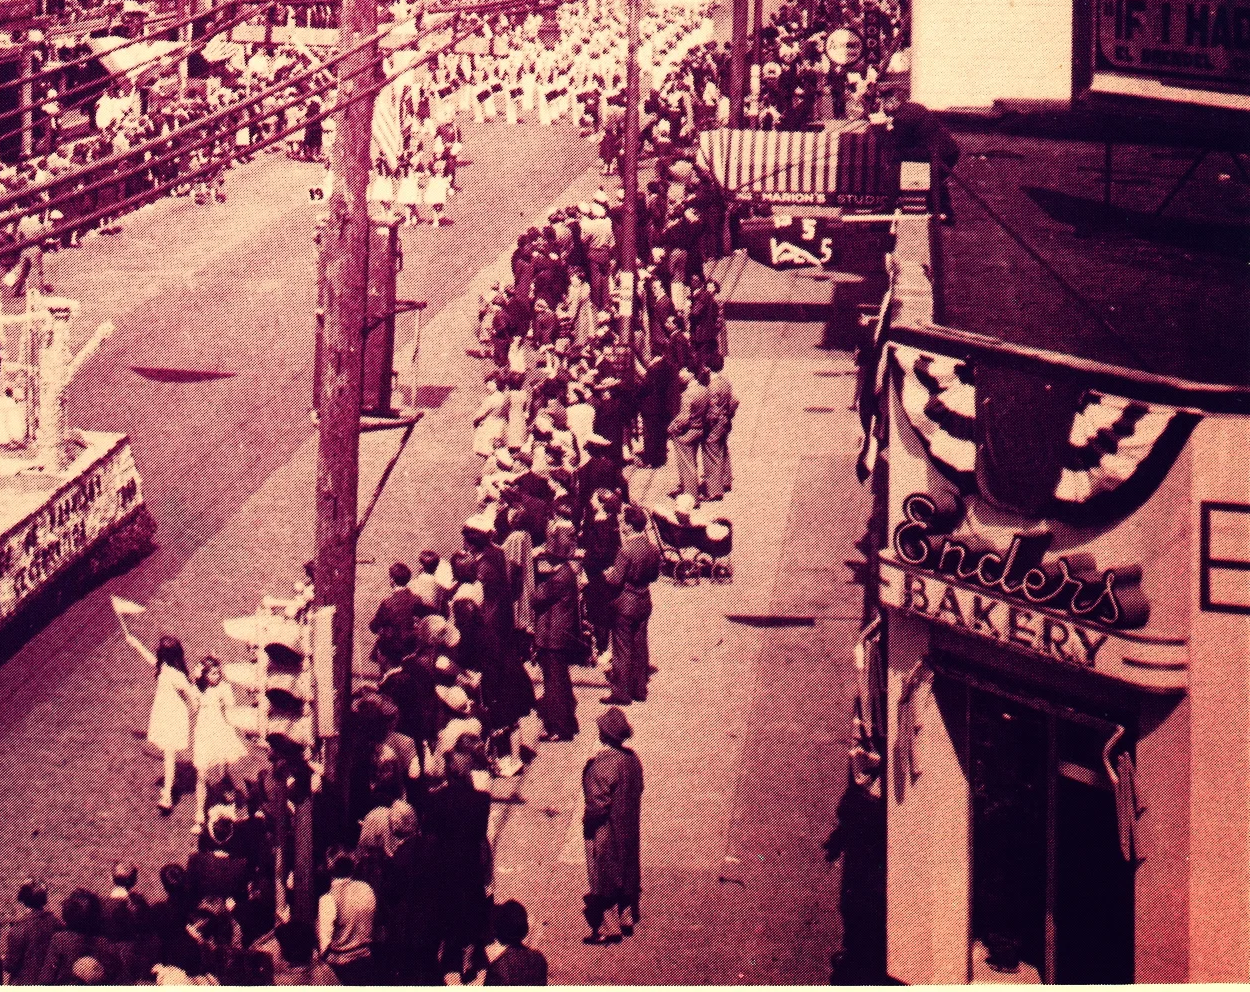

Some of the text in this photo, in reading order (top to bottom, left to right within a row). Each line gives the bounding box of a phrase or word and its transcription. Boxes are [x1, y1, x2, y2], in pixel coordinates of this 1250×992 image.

[1161, 2, 1171, 45] I
[894, 493, 1122, 624] Enders
[902, 570, 1109, 669] BAKERY
